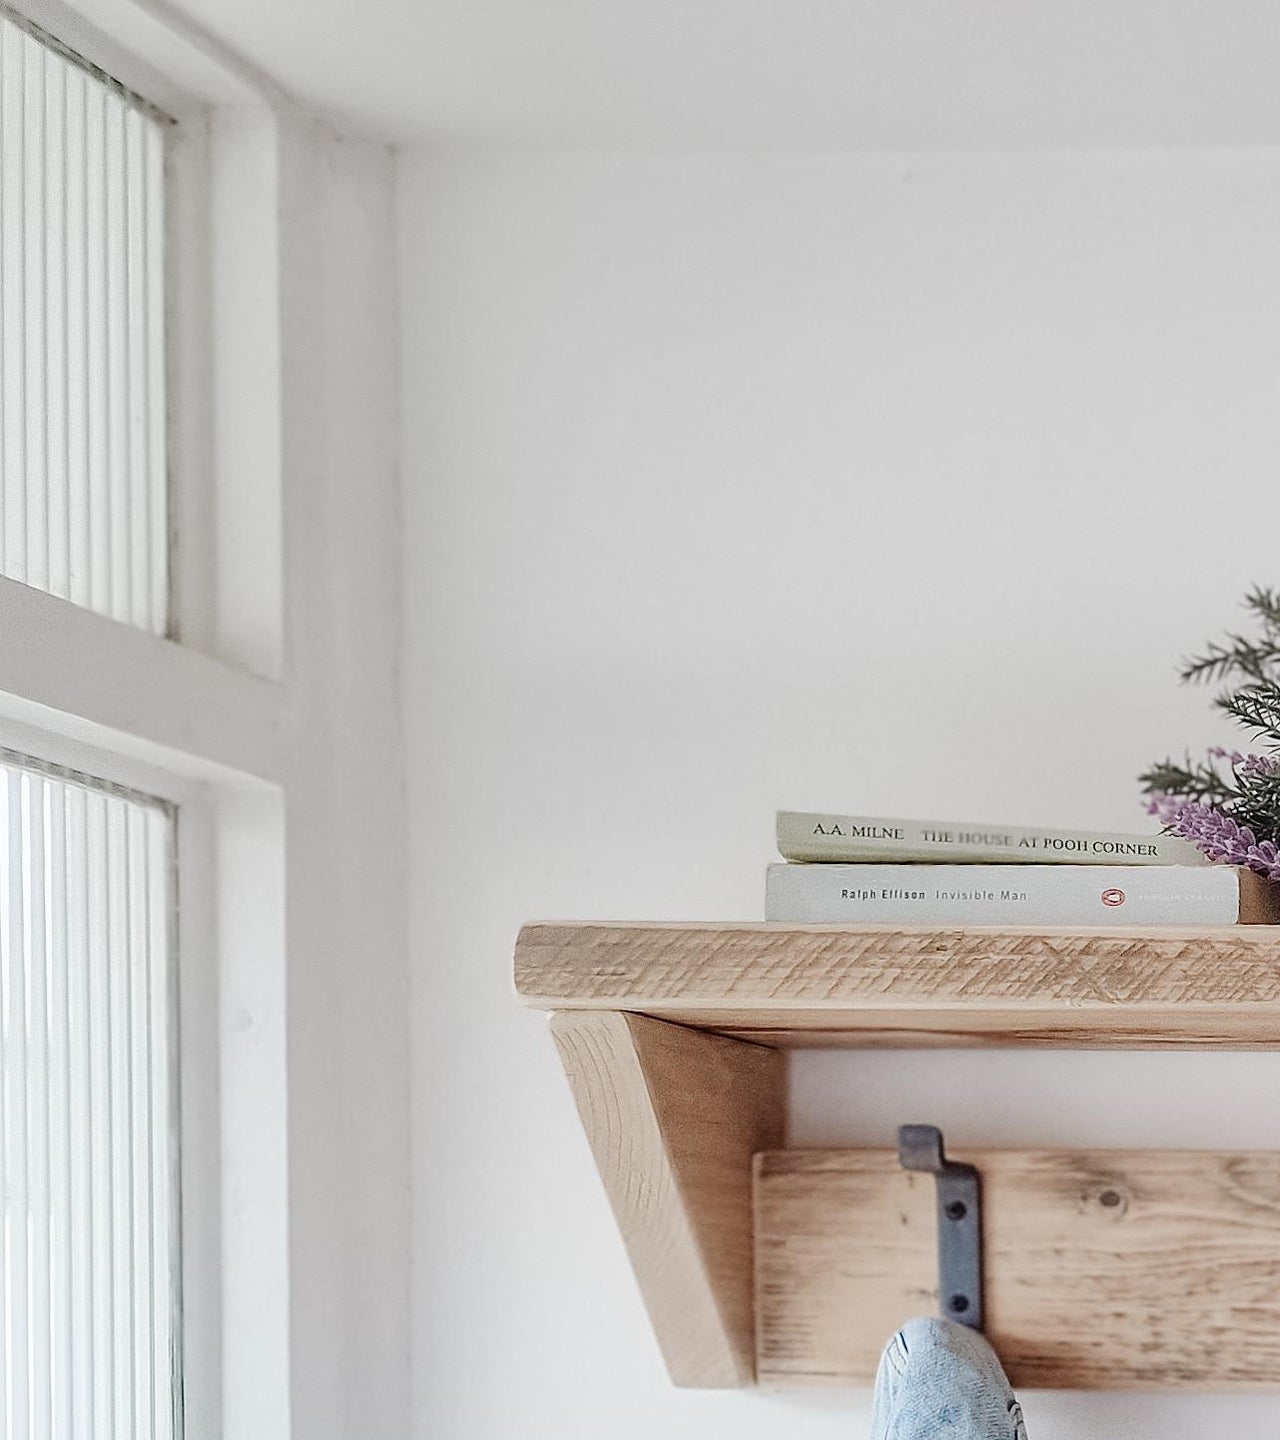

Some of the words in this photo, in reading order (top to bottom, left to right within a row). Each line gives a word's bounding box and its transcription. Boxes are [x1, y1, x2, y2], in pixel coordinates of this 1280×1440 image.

[813, 823, 847, 837] A.A.
[852, 825, 905, 840] MILNE
[920, 830, 954, 843] THE
[958, 832, 1014, 847] HOUSE
[1018, 836, 1039, 848] AT
[1043, 838, 1088, 852] POOH
[1092, 841, 1158, 857] CORNER
[841, 889, 876, 901] Ralph
[881, 889, 926, 901] Ellison
[935, 890, 994, 901] Invisible
[1000, 890, 1027, 901] Man
